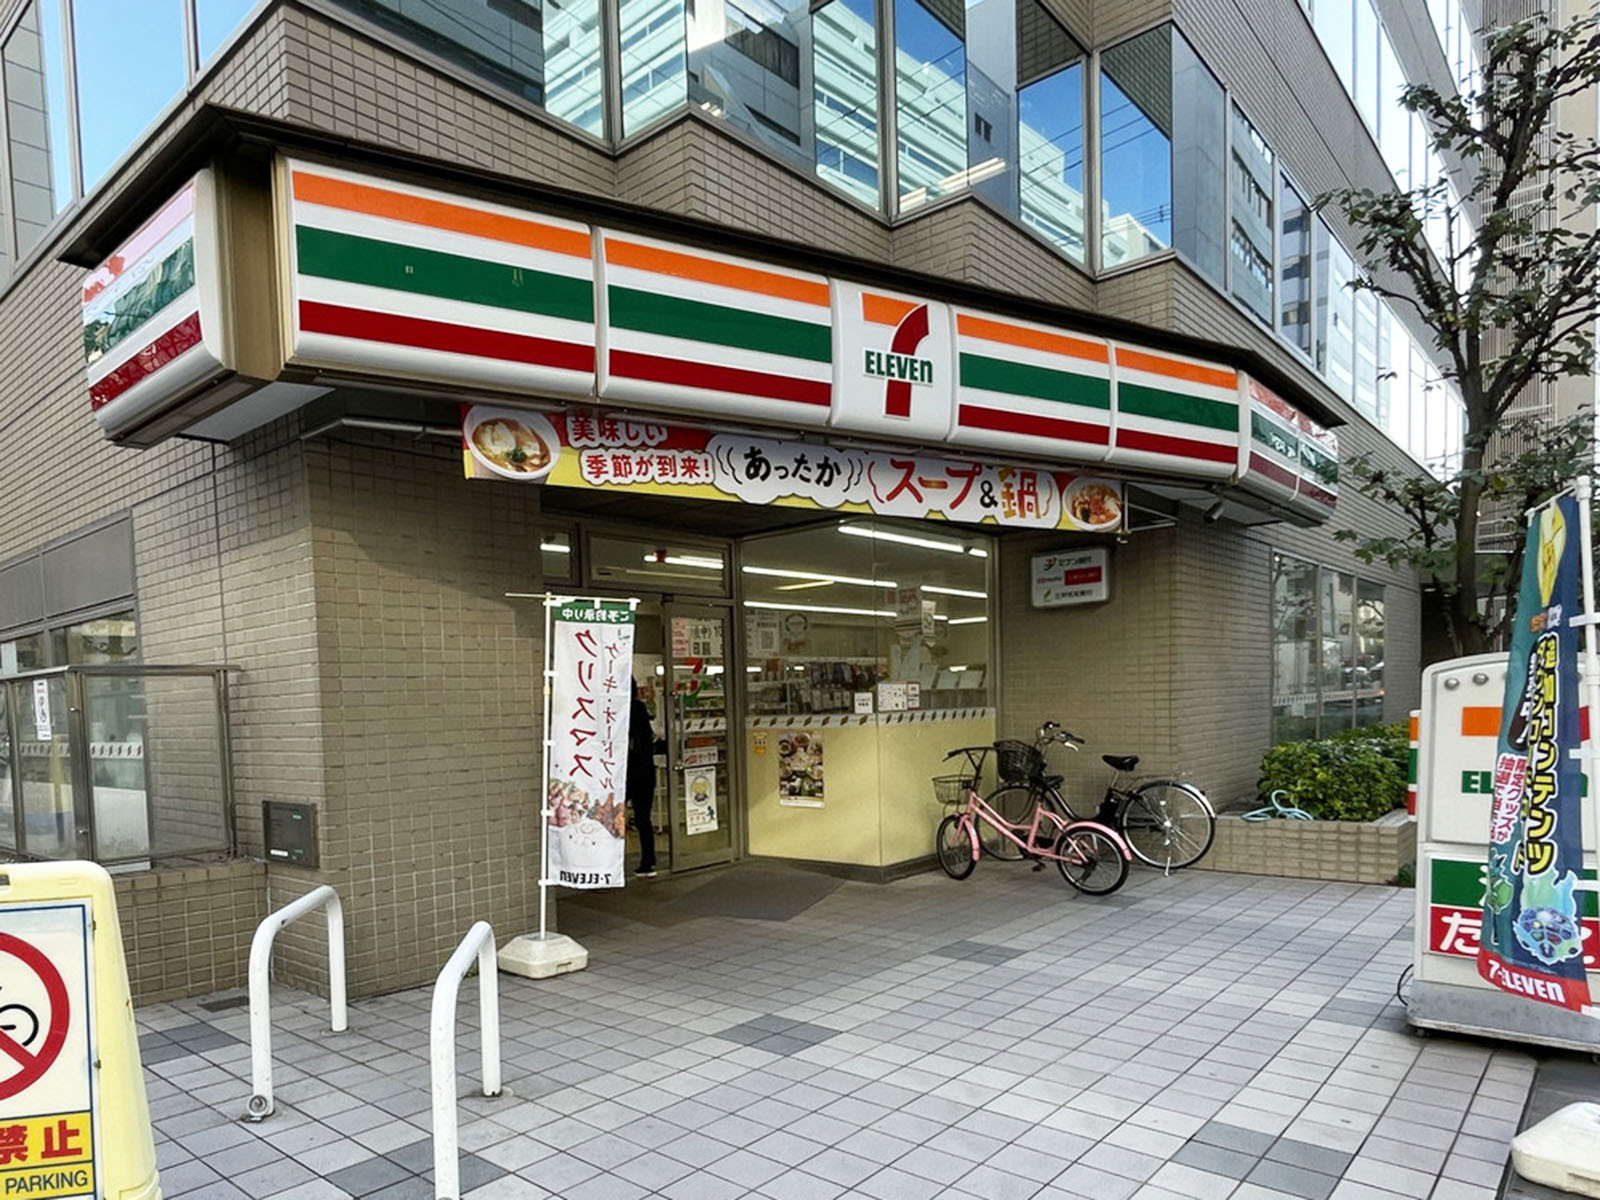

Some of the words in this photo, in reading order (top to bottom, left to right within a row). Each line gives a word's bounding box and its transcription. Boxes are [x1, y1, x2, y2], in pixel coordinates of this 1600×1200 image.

[861, 291, 930, 418] 7
[571, 414, 664, 442] 美味しい
[743, 446, 842, 488] あったか
[5, 1169, 89, 1195] PARKING
